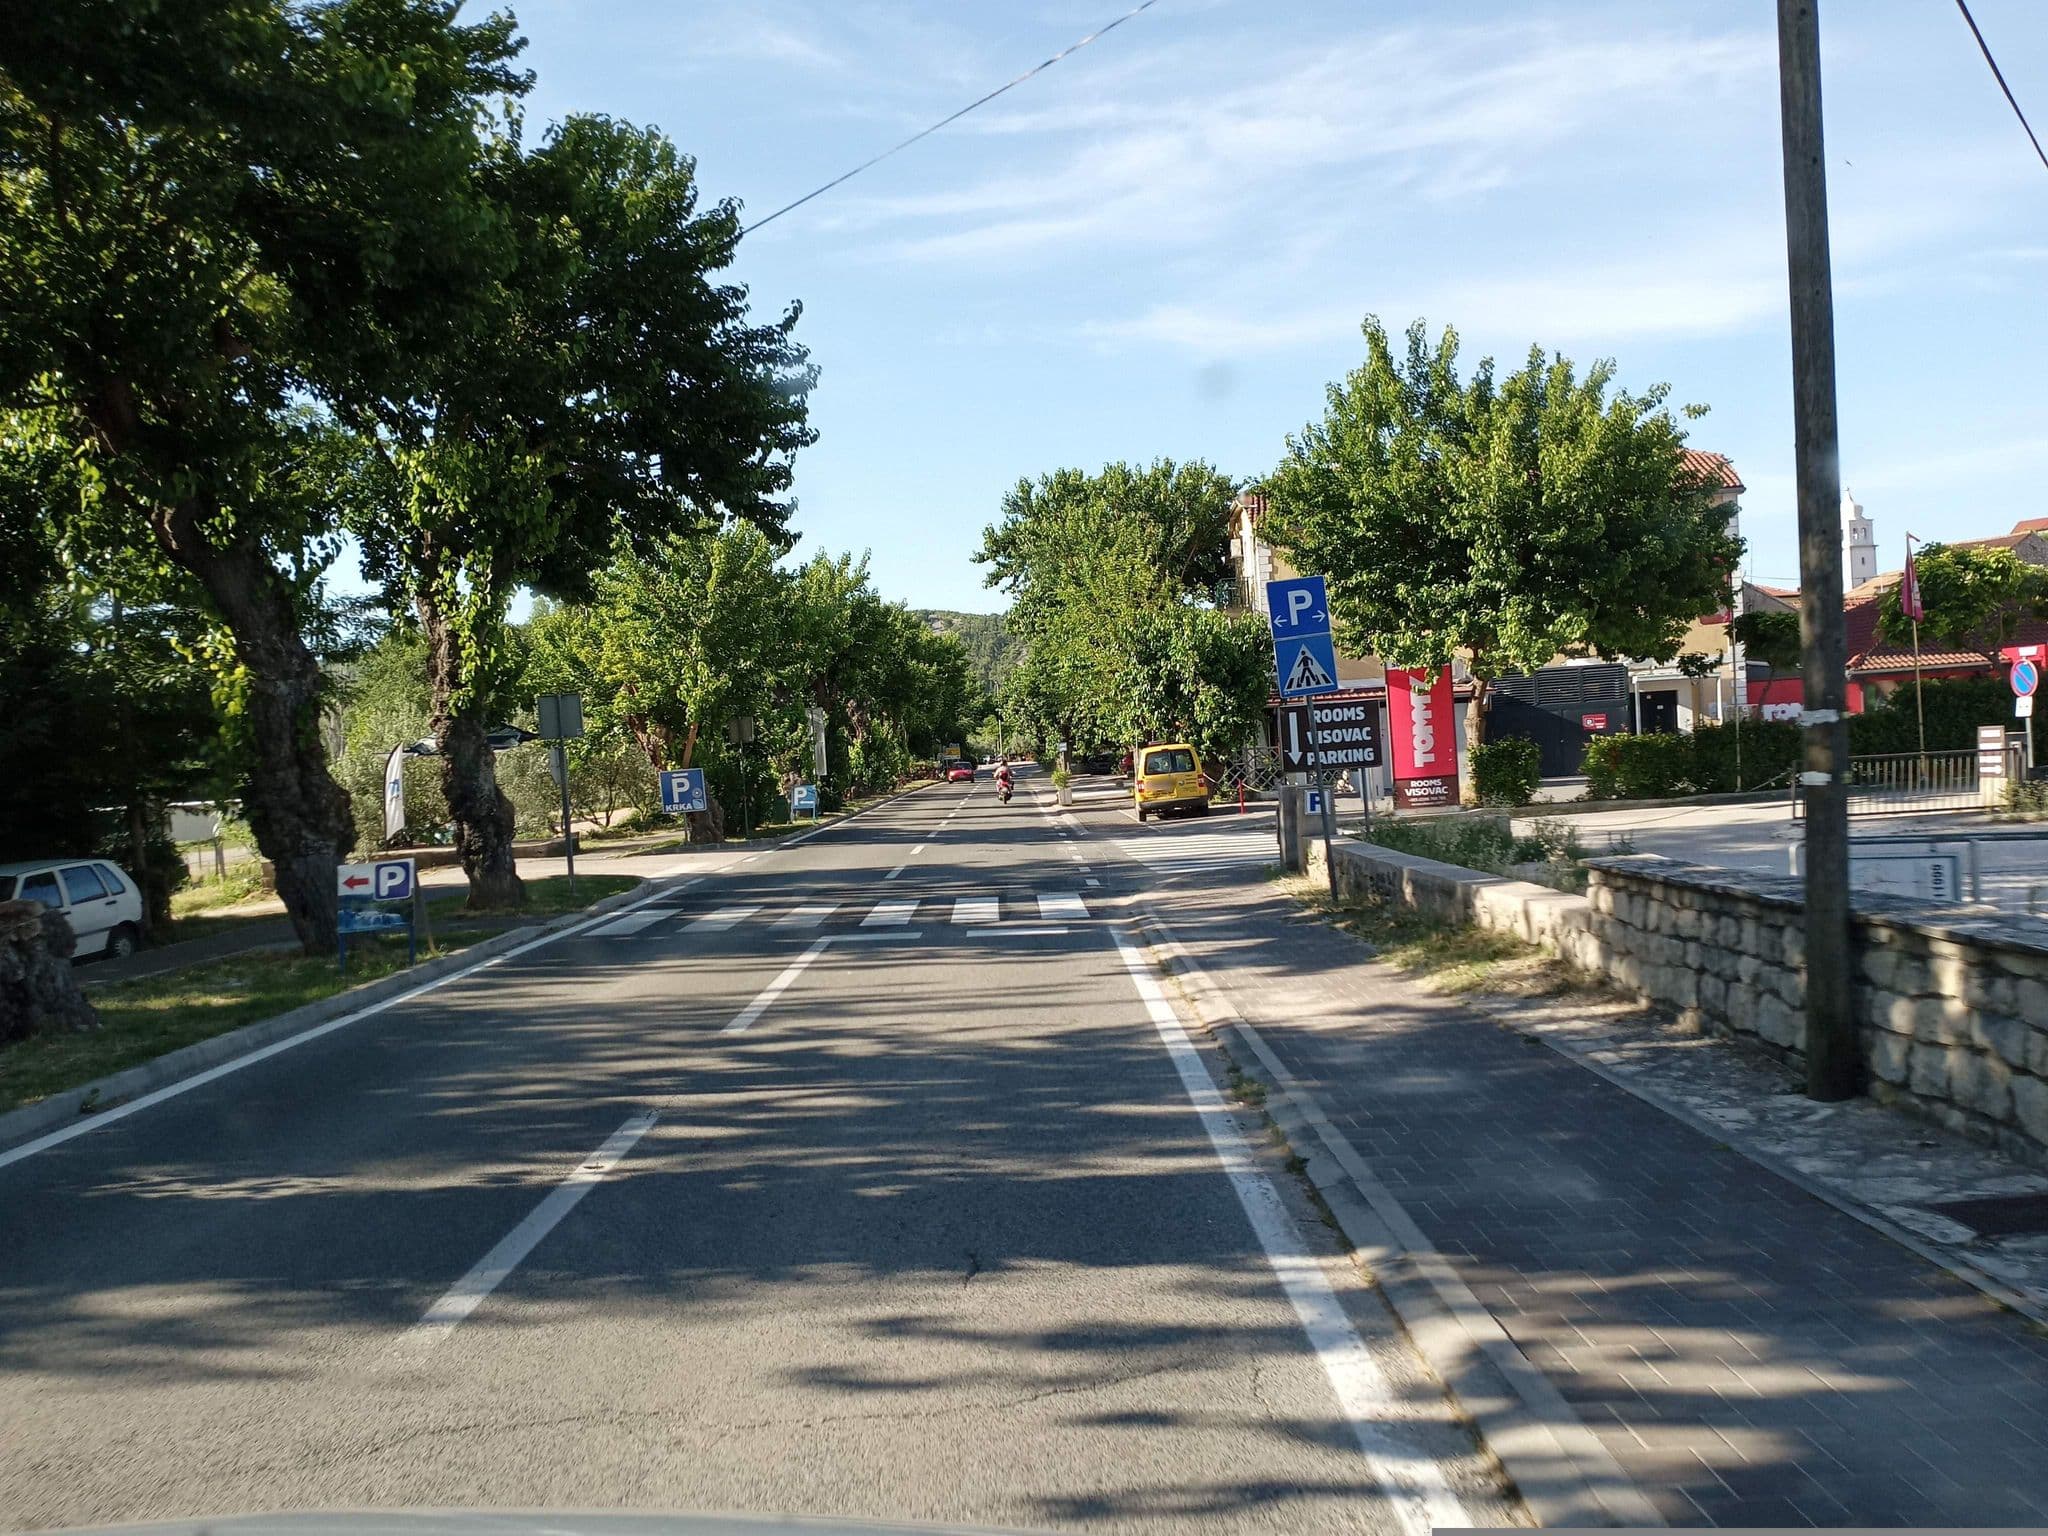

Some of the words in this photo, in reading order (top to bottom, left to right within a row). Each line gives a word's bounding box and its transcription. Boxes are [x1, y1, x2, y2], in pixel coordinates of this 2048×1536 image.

[1287, 589, 1313, 626] P
[1312, 706, 1366, 723] ROOMS
[1306, 747, 1375, 766] PARKING
[671, 777, 690, 803] P
[1404, 786, 1449, 797] VISOVAC
[1410, 778, 1442, 788] ROOMS
[794, 786, 808, 806] P
[1309, 793, 1321, 812] P
[665, 802, 693, 812] KRKA
[379, 865, 406, 897] P
